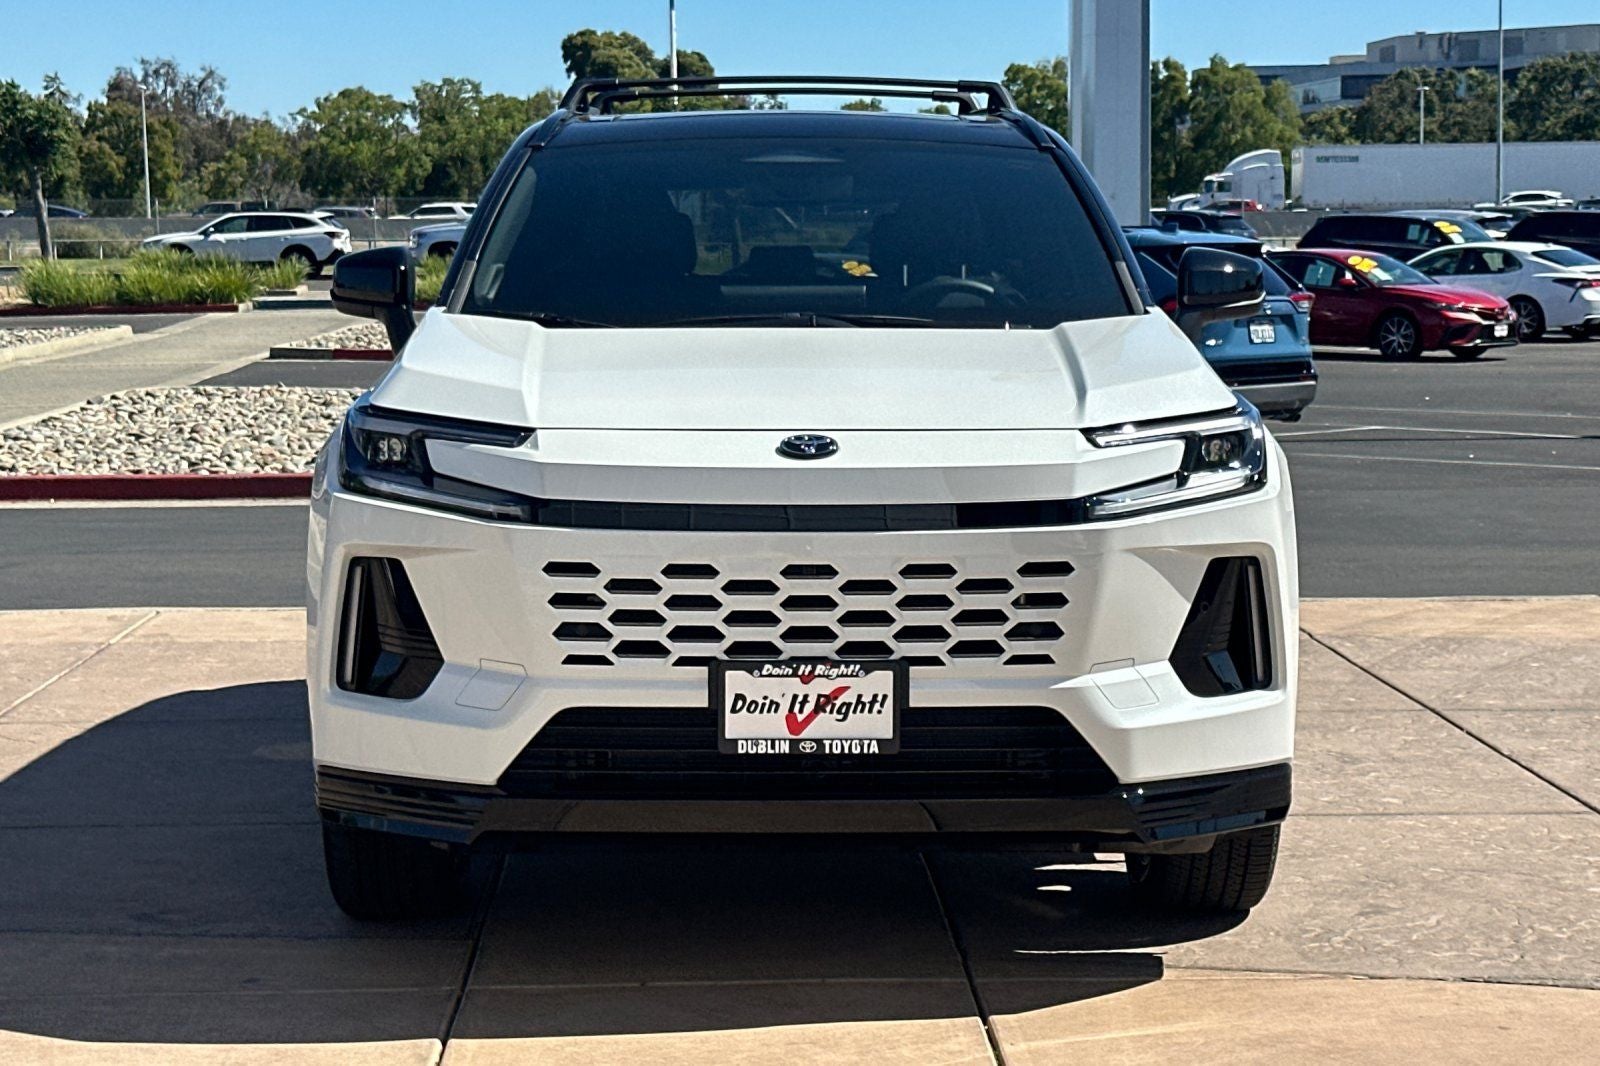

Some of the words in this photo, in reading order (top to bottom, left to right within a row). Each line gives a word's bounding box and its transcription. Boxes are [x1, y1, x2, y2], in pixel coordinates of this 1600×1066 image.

[761, 664, 796, 676] Doin'
[798, 664, 813, 676] It
[814, 664, 861, 679] Right!
[730, 693, 786, 714] Doin'
[788, 694, 810, 715] It
[814, 694, 889, 722] Right!
[737, 740, 790, 754] DUBLIN
[823, 740, 880, 754] TOYOTA
